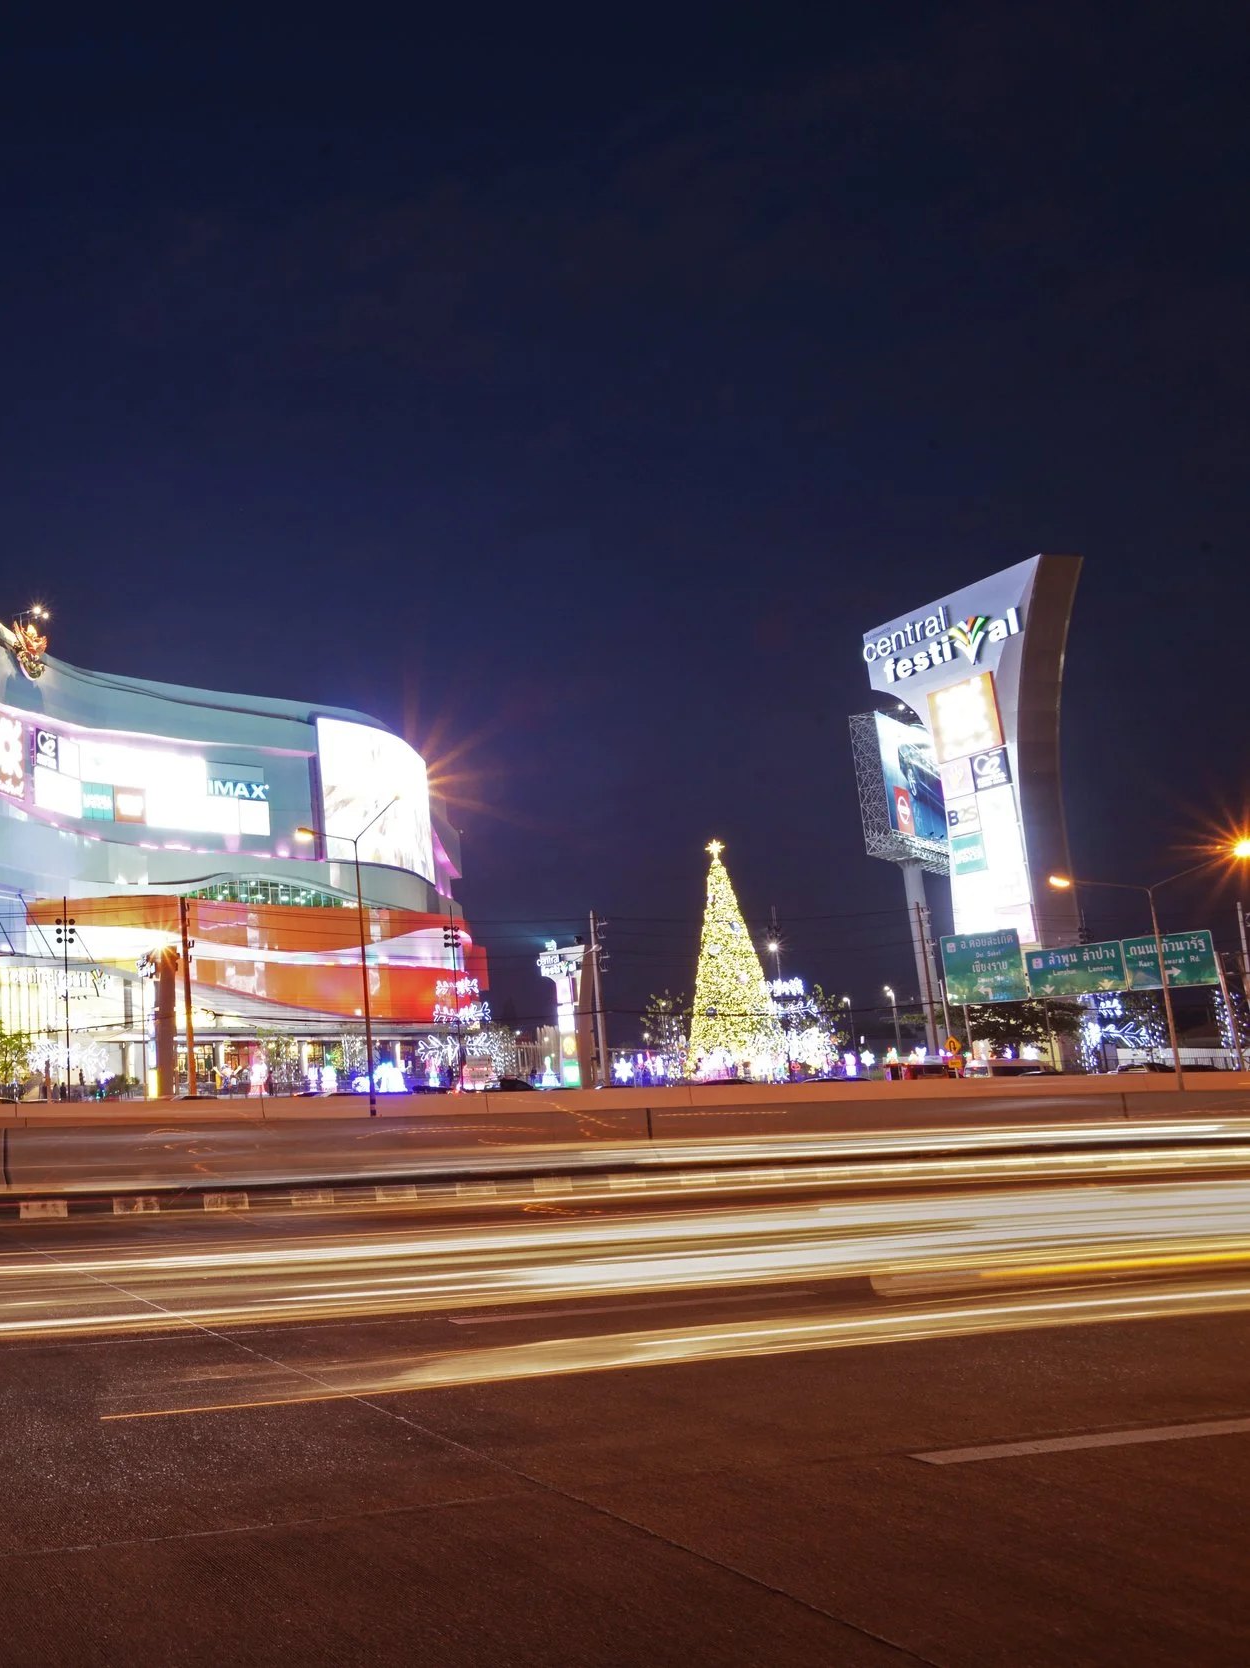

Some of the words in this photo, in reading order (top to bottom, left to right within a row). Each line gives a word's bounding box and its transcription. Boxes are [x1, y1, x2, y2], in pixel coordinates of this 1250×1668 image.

[863, 605, 948, 663] central
[883, 607, 1020, 684] festival
[947, 805, 978, 827] B2S
[1048, 952, 1078, 967] ลำพูน
[1082, 946, 1116, 962] ลำปาง
